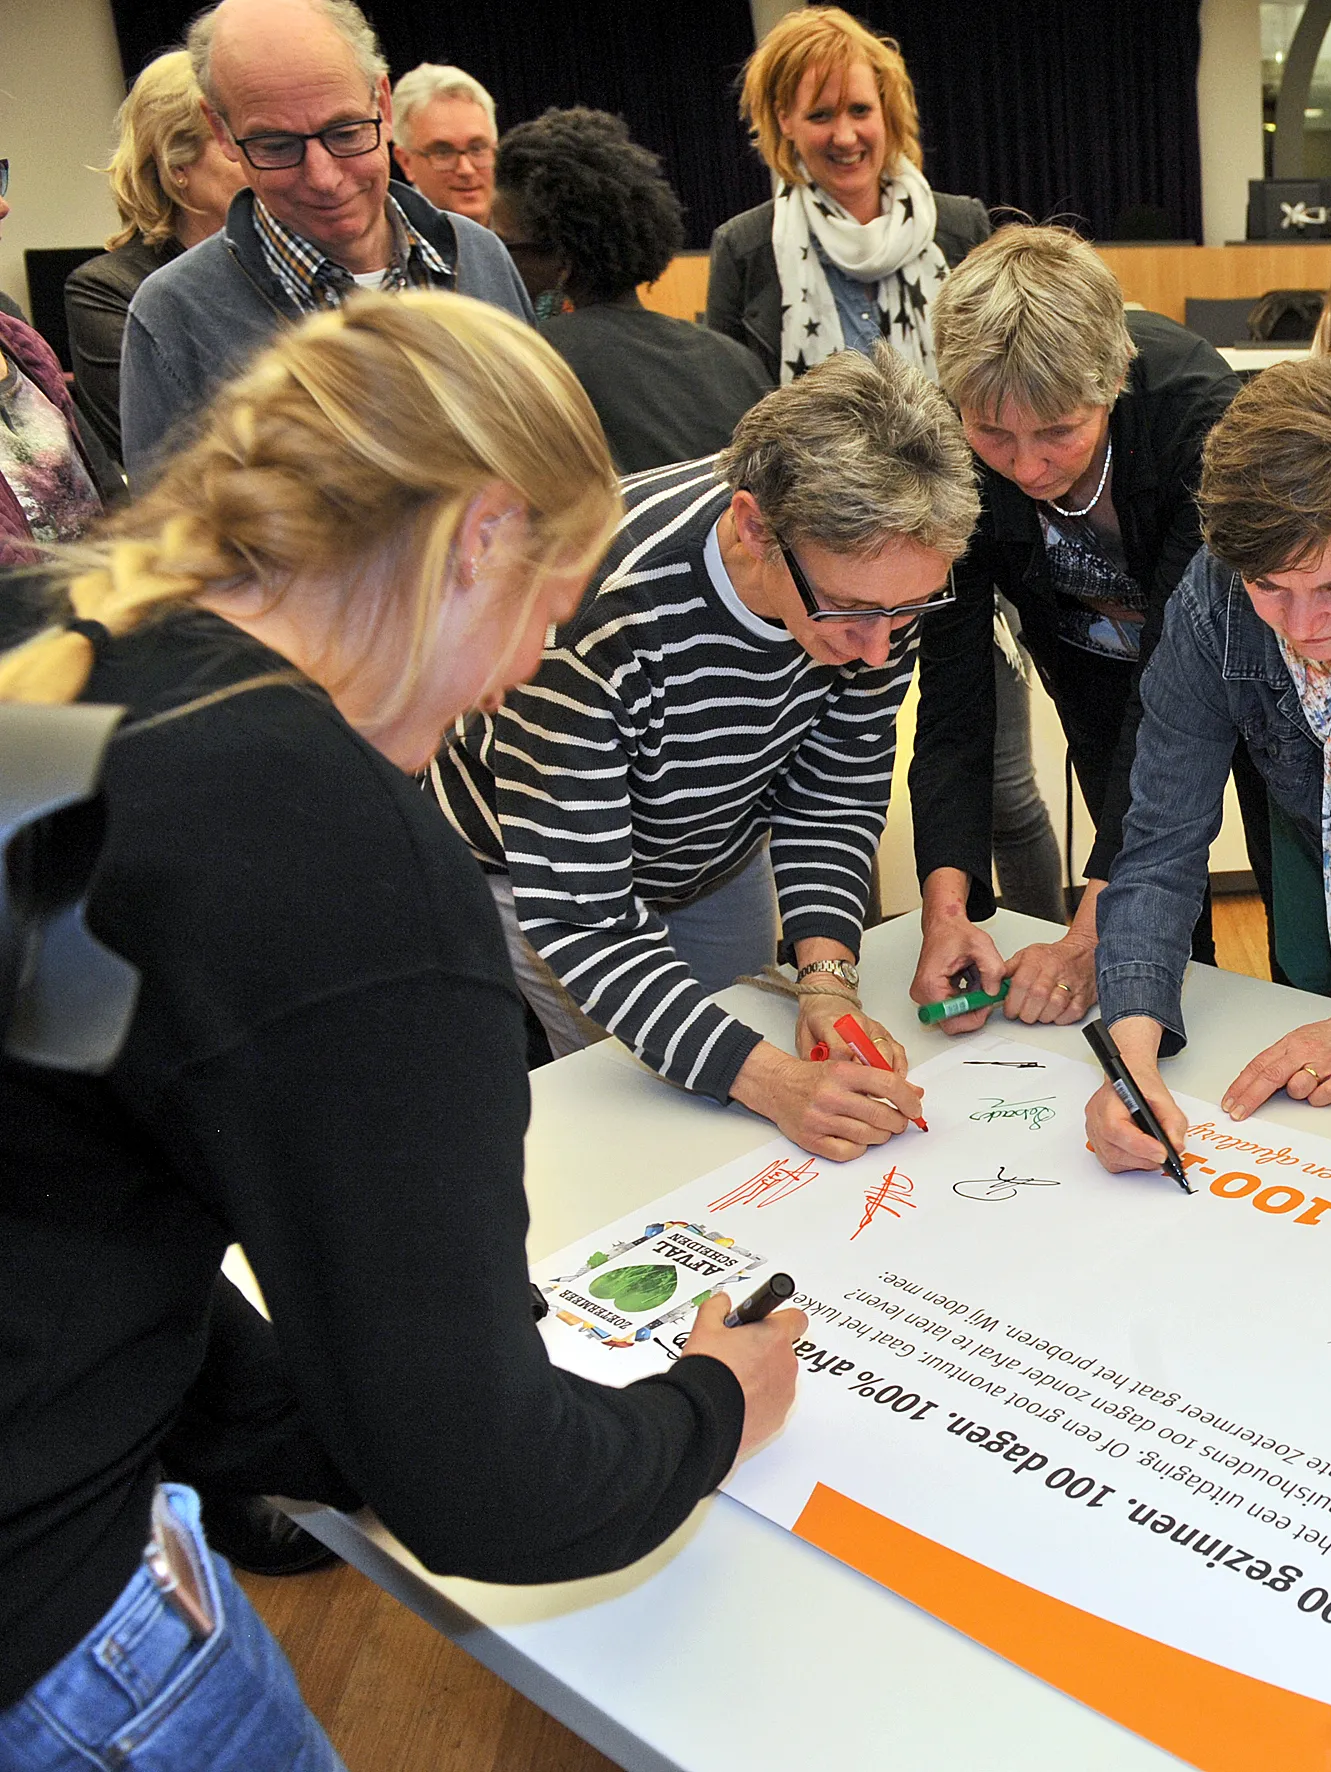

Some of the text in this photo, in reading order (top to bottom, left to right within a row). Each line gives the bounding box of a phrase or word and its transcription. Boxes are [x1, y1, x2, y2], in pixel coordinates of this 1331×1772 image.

[652, 1240, 726, 1277] AFVAL
[667, 1232, 739, 1267] SCHEIDEN
[878, 1271, 924, 1295] mee:
[558, 1289, 633, 1330] ZOETERMEER
[843, 1288, 906, 1321] leven?
[922, 1290, 970, 1316] doen
[837, 1315, 874, 1339] het
[903, 1313, 953, 1342] laten
[963, 1308, 1000, 1333] Wij
[791, 1337, 856, 1377] afva
[869, 1330, 916, 1358] Gaat
[951, 1334, 974, 1351] te
[968, 1344, 1022, 1370] afval
[1005, 1327, 1098, 1371] proberen.
[917, 1351, 1007, 1397] avontuur.
[1018, 1367, 1092, 1402] zonder
[1091, 1365, 1130, 1390] het
[847, 1371, 939, 1421] 100%
[1003, 1392, 1066, 1423] groot
[1128, 1381, 1182, 1407] gaat
[1061, 1418, 1103, 1442] een
[1090, 1397, 1156, 1433] dagen
[946, 1412, 1049, 1475] dagen.
[1095, 1438, 1130, 1458] Of
[1157, 1427, 1198, 1449] 100
[1176, 1404, 1306, 1465] Zoetermeer
[1044, 1467, 1117, 1508] 100
[1136, 1450, 1245, 1509] uitdaging.
[1246, 1502, 1292, 1530] een
[1127, 1498, 1304, 1593] gezinnen.
